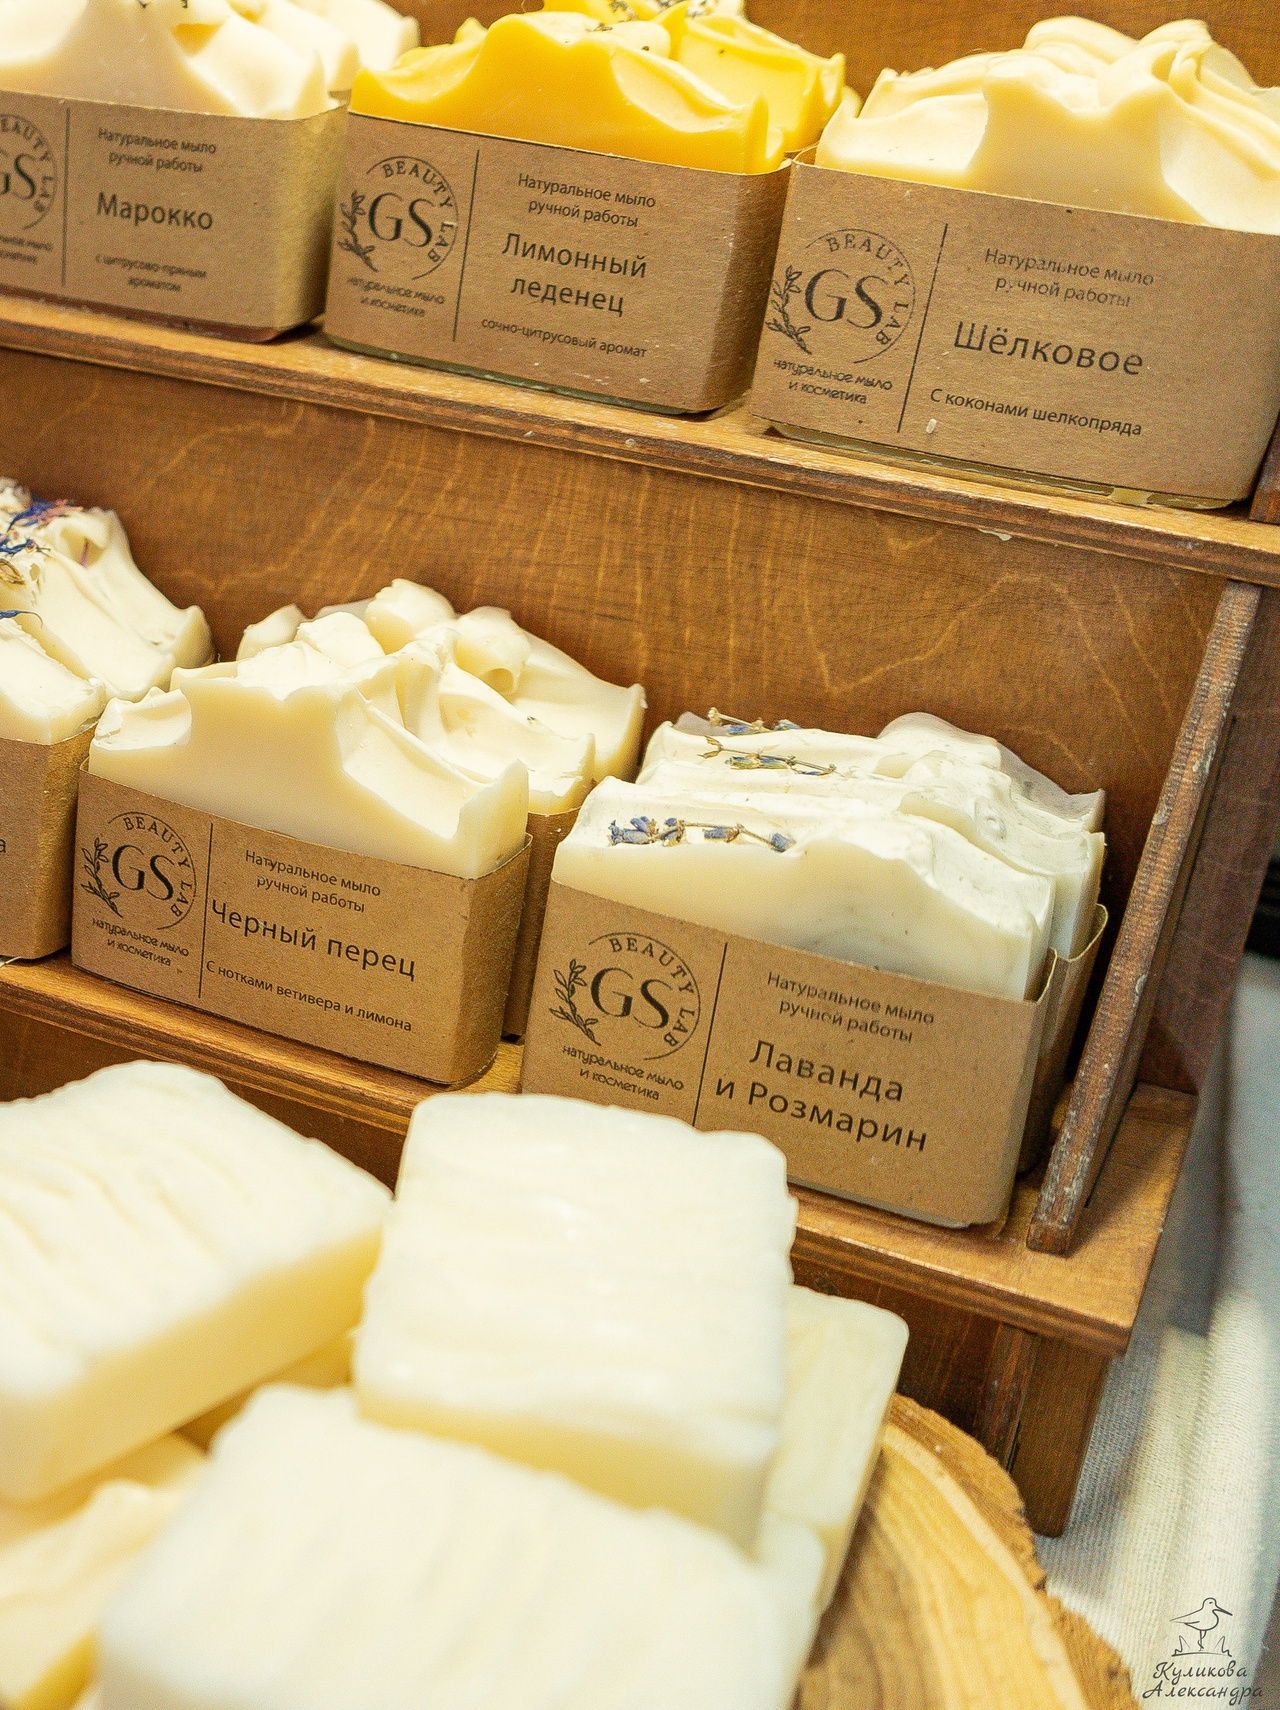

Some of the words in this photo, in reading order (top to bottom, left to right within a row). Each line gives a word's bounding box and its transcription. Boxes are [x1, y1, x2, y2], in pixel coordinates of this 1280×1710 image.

[98, 127, 179, 153] Натуральное
[181, 140, 217, 155] мыло
[108, 151, 153, 170] ручной
[156, 155, 203, 173] работы
[96, 191, 214, 231] Марокко
[382, 160, 454, 210] BEAUTY
[427, 219, 454, 264] LAB
[518, 172, 612, 203] Натуральное
[614, 192, 657, 208] мыло
[528, 198, 580, 220] ручной
[583, 207, 639, 229] работы
[368, 192, 435, 248] GS
[501, 232, 649, 279] Лимонный
[984, 248, 1100, 280] Натуральное
[1103, 268, 1155, 286] мыло
[510, 275, 624, 317] леденец
[805, 268, 889, 329] GS
[825, 234, 912, 288] BEAUTY
[874, 300, 910, 347] LAB
[1063, 284, 1131, 310] работы
[481, 317, 596, 350] сочно-цитрусовый
[599, 339, 648, 359] аромат
[953, 320, 1144, 376] Шёлковое
[773, 360, 854, 386] натуральное
[855, 376, 893, 391] мыло
[800, 383, 867, 405] косметика
[930, 388, 941, 403] С
[944, 392, 1028, 419] коконами
[1031, 403, 1142, 437] шелкопряда
[112, 843, 176, 901] GS
[122, 816, 192, 869] BEAUTY
[170, 879, 194, 918] LAB
[245, 849, 338, 885] Натуральное
[340, 876, 381, 897] мыло
[256, 874, 308, 902] ручной
[311, 887, 366, 913] работы
[91, 916, 158, 946] натуральное
[159, 938, 190, 957] мыло
[211, 898, 318, 951] Черный
[326, 938, 417, 981] перец
[206, 960, 215, 974] С
[216, 963, 273, 993] нотками
[276, 980, 342, 1014] ветивера
[344, 1002, 354, 1014] и
[356, 1005, 413, 1033] лимона
[590, 966, 672, 1030] GS
[609, 936, 696, 997] BEAUTY
[662, 1004, 697, 1050] LAB
[767, 970, 882, 1014] Натуральное
[885, 1004, 936, 1026] мыло
[778, 999, 843, 1030] ручной
[847, 1016, 914, 1043] работы
[561, 1044, 646, 1080] натуральное
[647, 1070, 685, 1092] мыло
[579, 1067, 589, 1079] и
[591, 1071, 660, 1102] косметика
[749, 1039, 905, 1103] Лаванда
[715, 1078, 736, 1099] и
[747, 1080, 928, 1152] Розмарин
